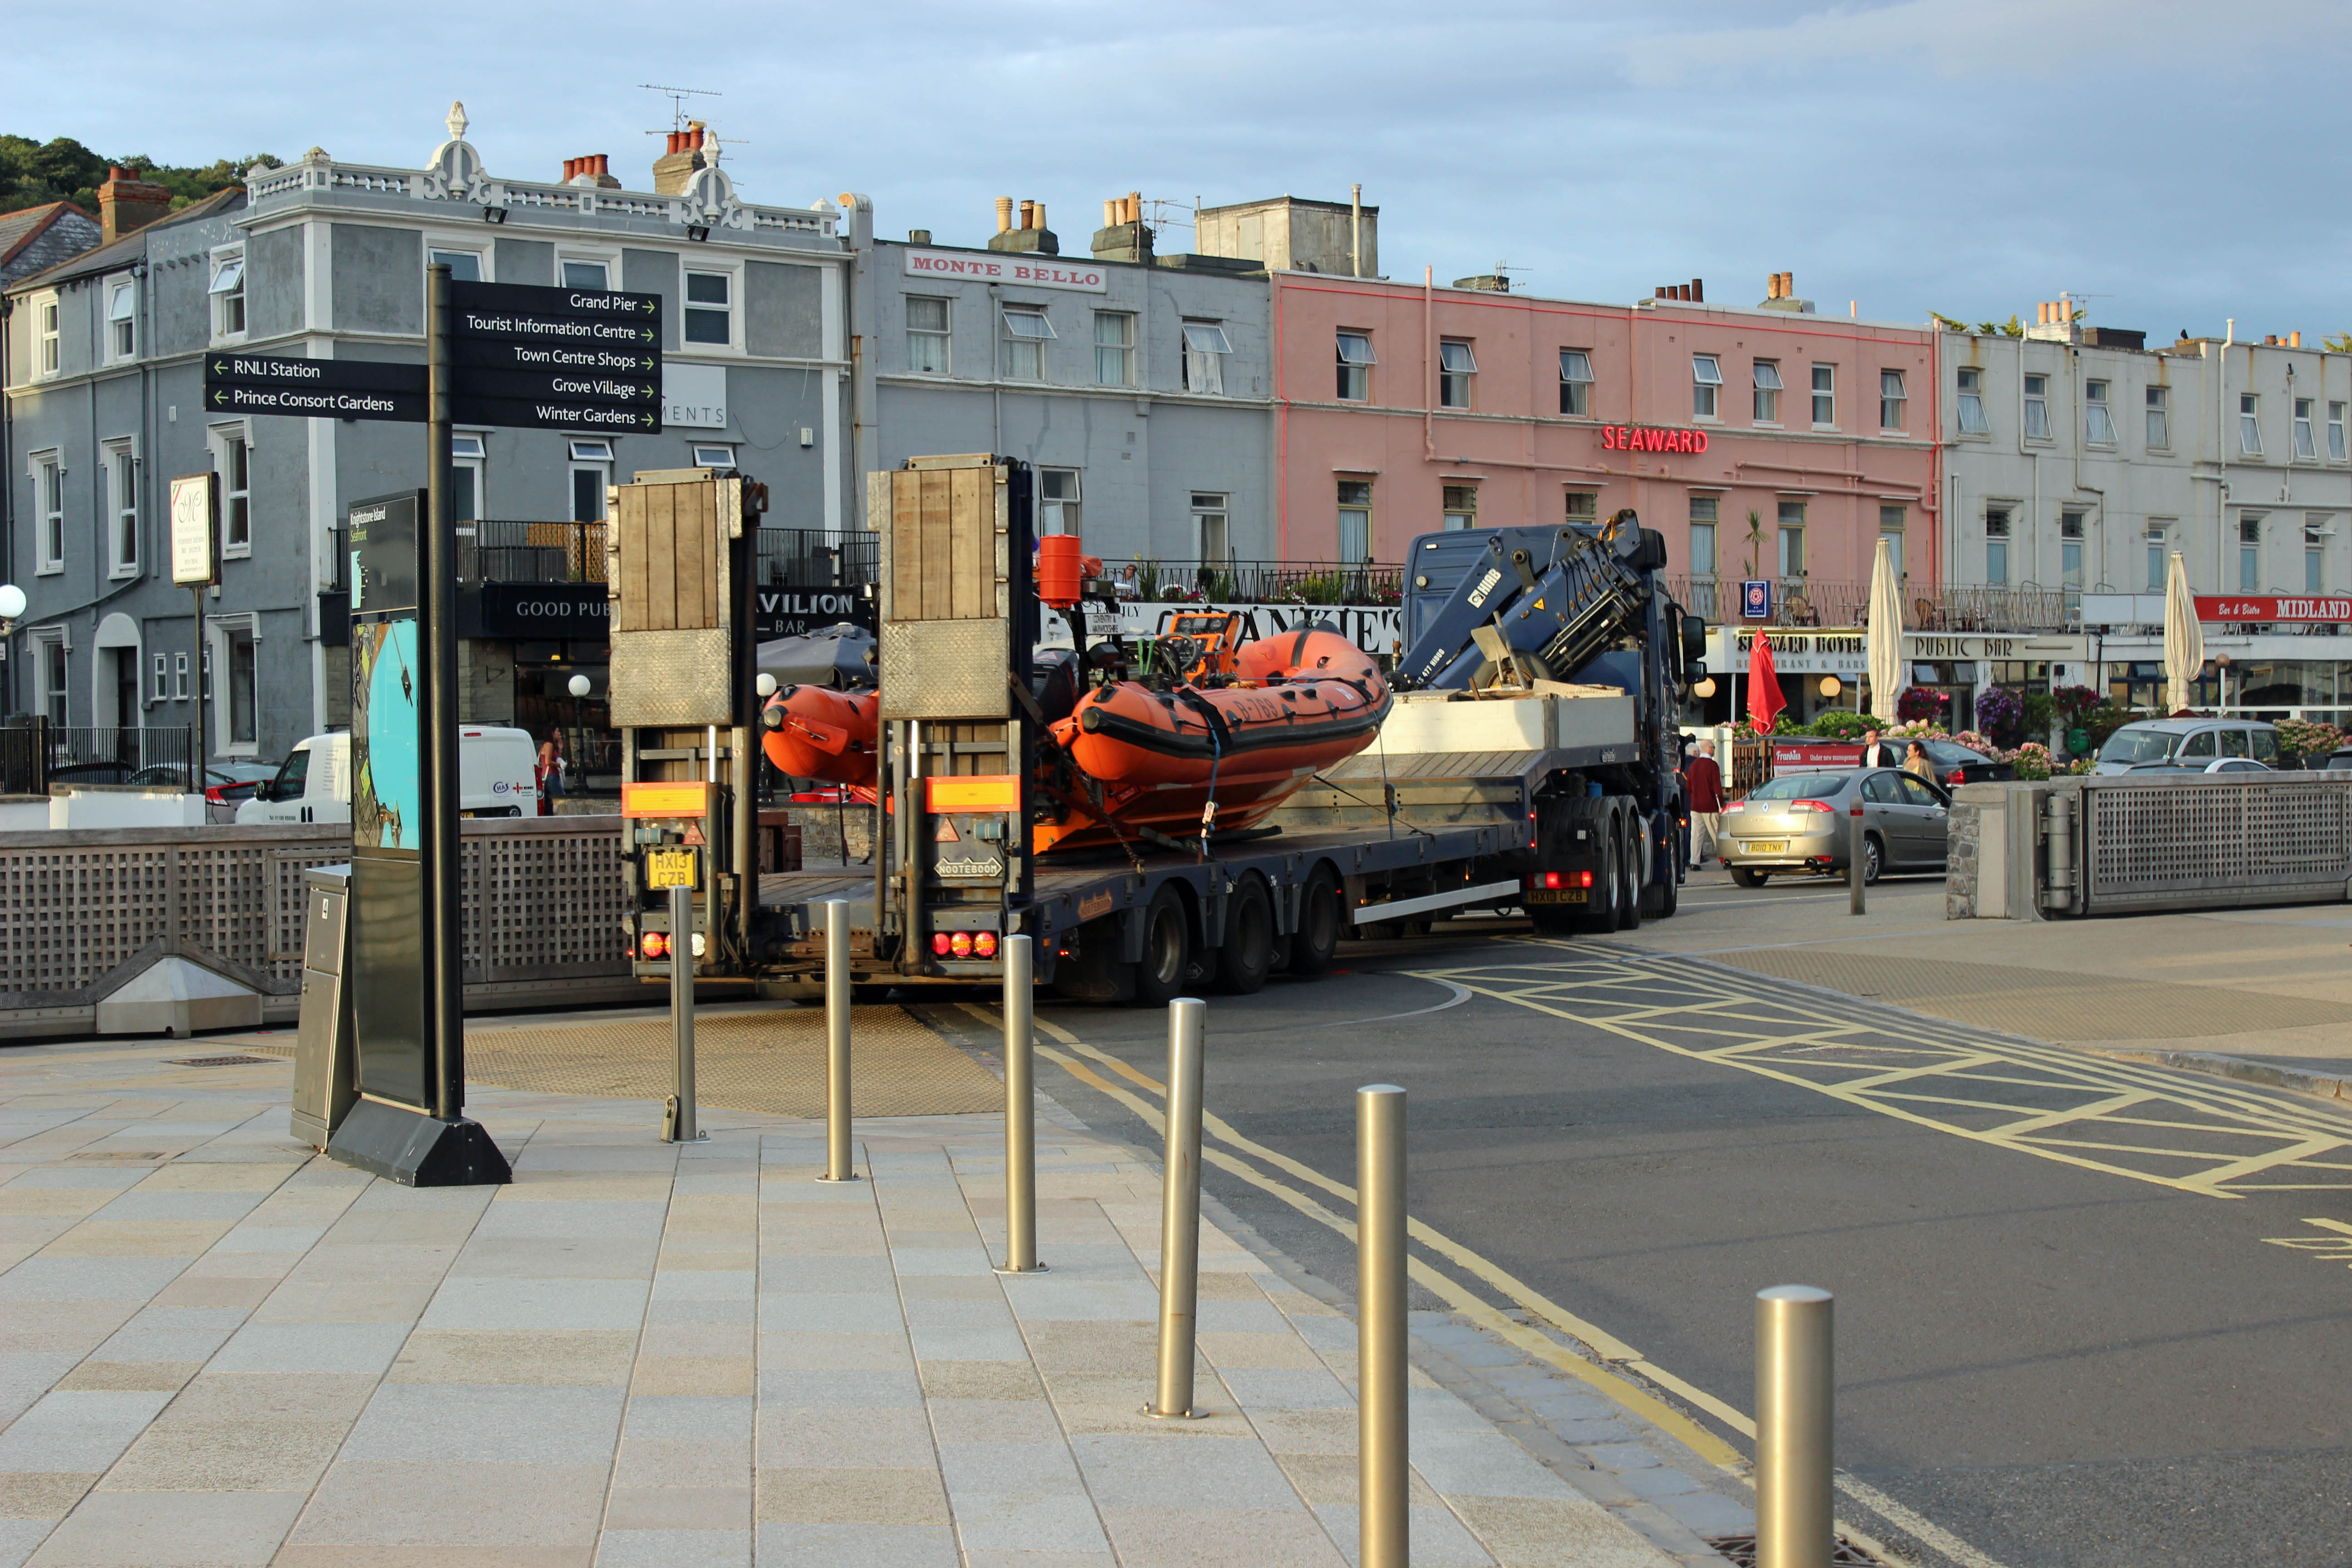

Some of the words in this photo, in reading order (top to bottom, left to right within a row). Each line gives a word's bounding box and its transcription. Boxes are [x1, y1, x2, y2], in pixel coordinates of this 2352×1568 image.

[913, 257, 1001, 276] MONTE
[1015, 266, 1100, 285] BELLO
[570, 294, 609, 309] Grand
[613, 297, 637, 311] Pier
[467, 315, 512, 331] Tourist
[515, 318, 591, 336] Information
[593, 324, 636, 339] Centre
[514, 347, 549, 362] Town
[553, 350, 595, 365] Centre
[598, 352, 636, 371] Shops
[235, 360, 267, 375] RNLI
[270, 362, 320, 378] Station
[553, 378, 591, 393] Grove
[593, 380, 636, 399] Village
[235, 390, 277, 405] Prince
[279, 392, 335, 408] Consort
[338, 395, 394, 411] Gardens
[536, 406, 581, 421] Winter
[583, 409, 636, 424] Gardens
[1602, 425, 1708, 454] SEAWARD
[350, 511, 373, 528] Knightstone
[374, 506, 386, 521] Island
[351, 529, 367, 543] Seafront
[1477, 568, 1502, 596] HIAB
[517, 602, 571, 616] GOOD
[756, 593, 853, 613] VILION
[2219, 603, 2230, 615] Bar
[2233, 603, 2239, 615] &
[2242, 603, 2260, 615] Bistro
[2276, 599, 2351, 619] MIDLAND
[775, 620, 805, 633] BAR
[1816, 636, 1867, 653] HOTEL
[1916, 637, 1970, 657] PUBLIC
[1984, 638, 2012, 657] BAR
[1422, 665, 1432, 677] 477
[1429, 648, 1445, 667] HIDUO
[1821, 660, 1827, 669] &
[1838, 660, 1866, 669] BARS
[1233, 698, 1278, 721] B-769
[1832, 754, 1859, 762] management
[1769, 843, 1782, 852] TNX
[656, 854, 687, 868] HX13
[939, 865, 998, 874] NOOTEBOOM
[658, 872, 686, 886] CZB
[1531, 891, 1557, 902] HX13
[1560, 890, 1583, 902] CZB
[323, 901, 327, 917] 4
